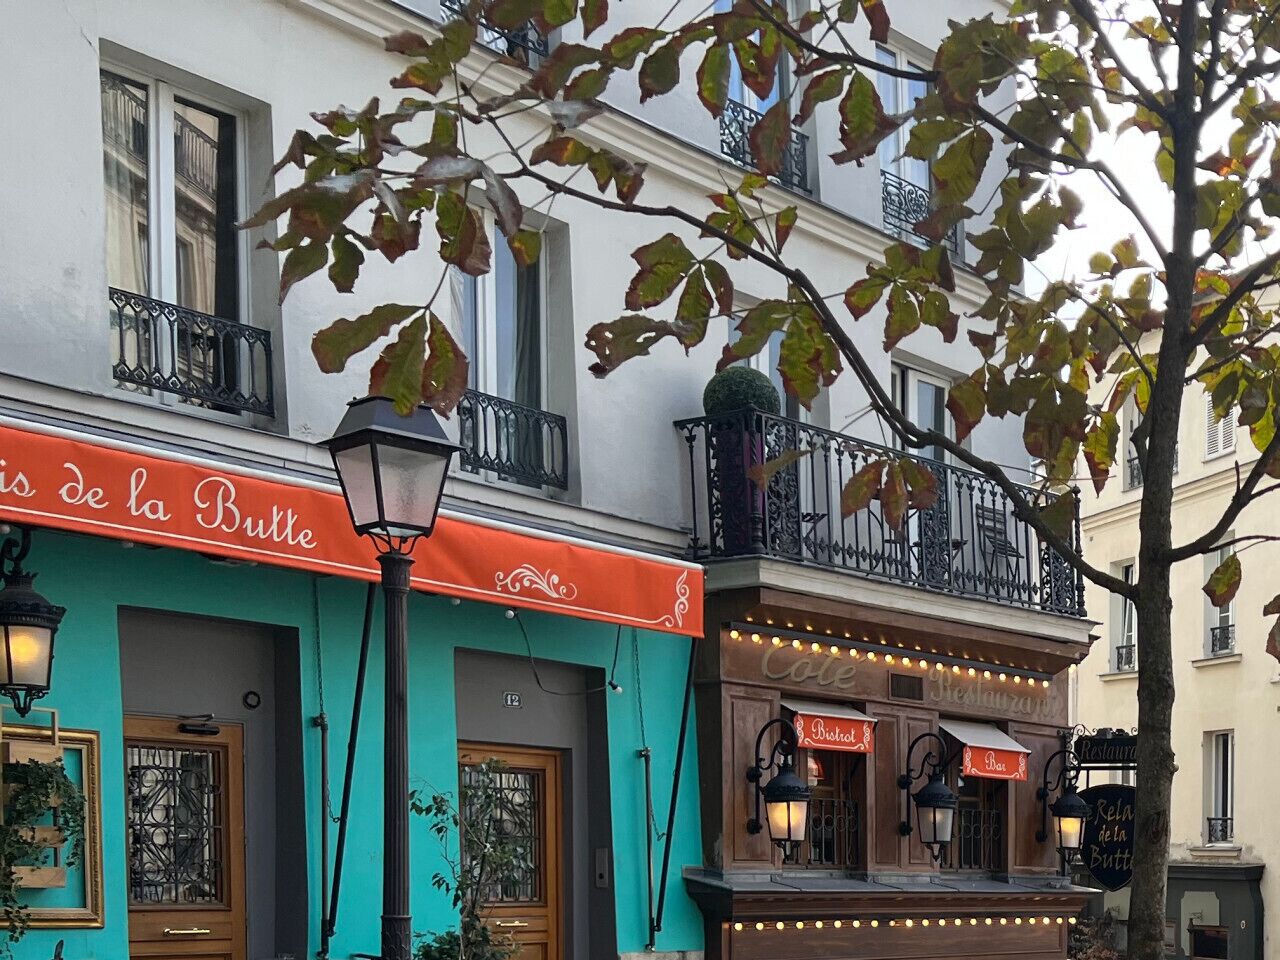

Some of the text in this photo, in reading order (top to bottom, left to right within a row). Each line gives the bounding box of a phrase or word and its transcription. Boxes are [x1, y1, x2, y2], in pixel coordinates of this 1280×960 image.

[58, 462, 110, 509] de
[126, 467, 172, 521] la
[193, 476, 318, 549] Butte
[506, 694, 519, 706] 12
[811, 718, 856, 743] Bistrot
[984, 751, 1007, 772] Bar
[1080, 740, 1138, 761] Restaura
[1095, 798, 1136, 825] Rela
[1098, 825, 1128, 847] de la
